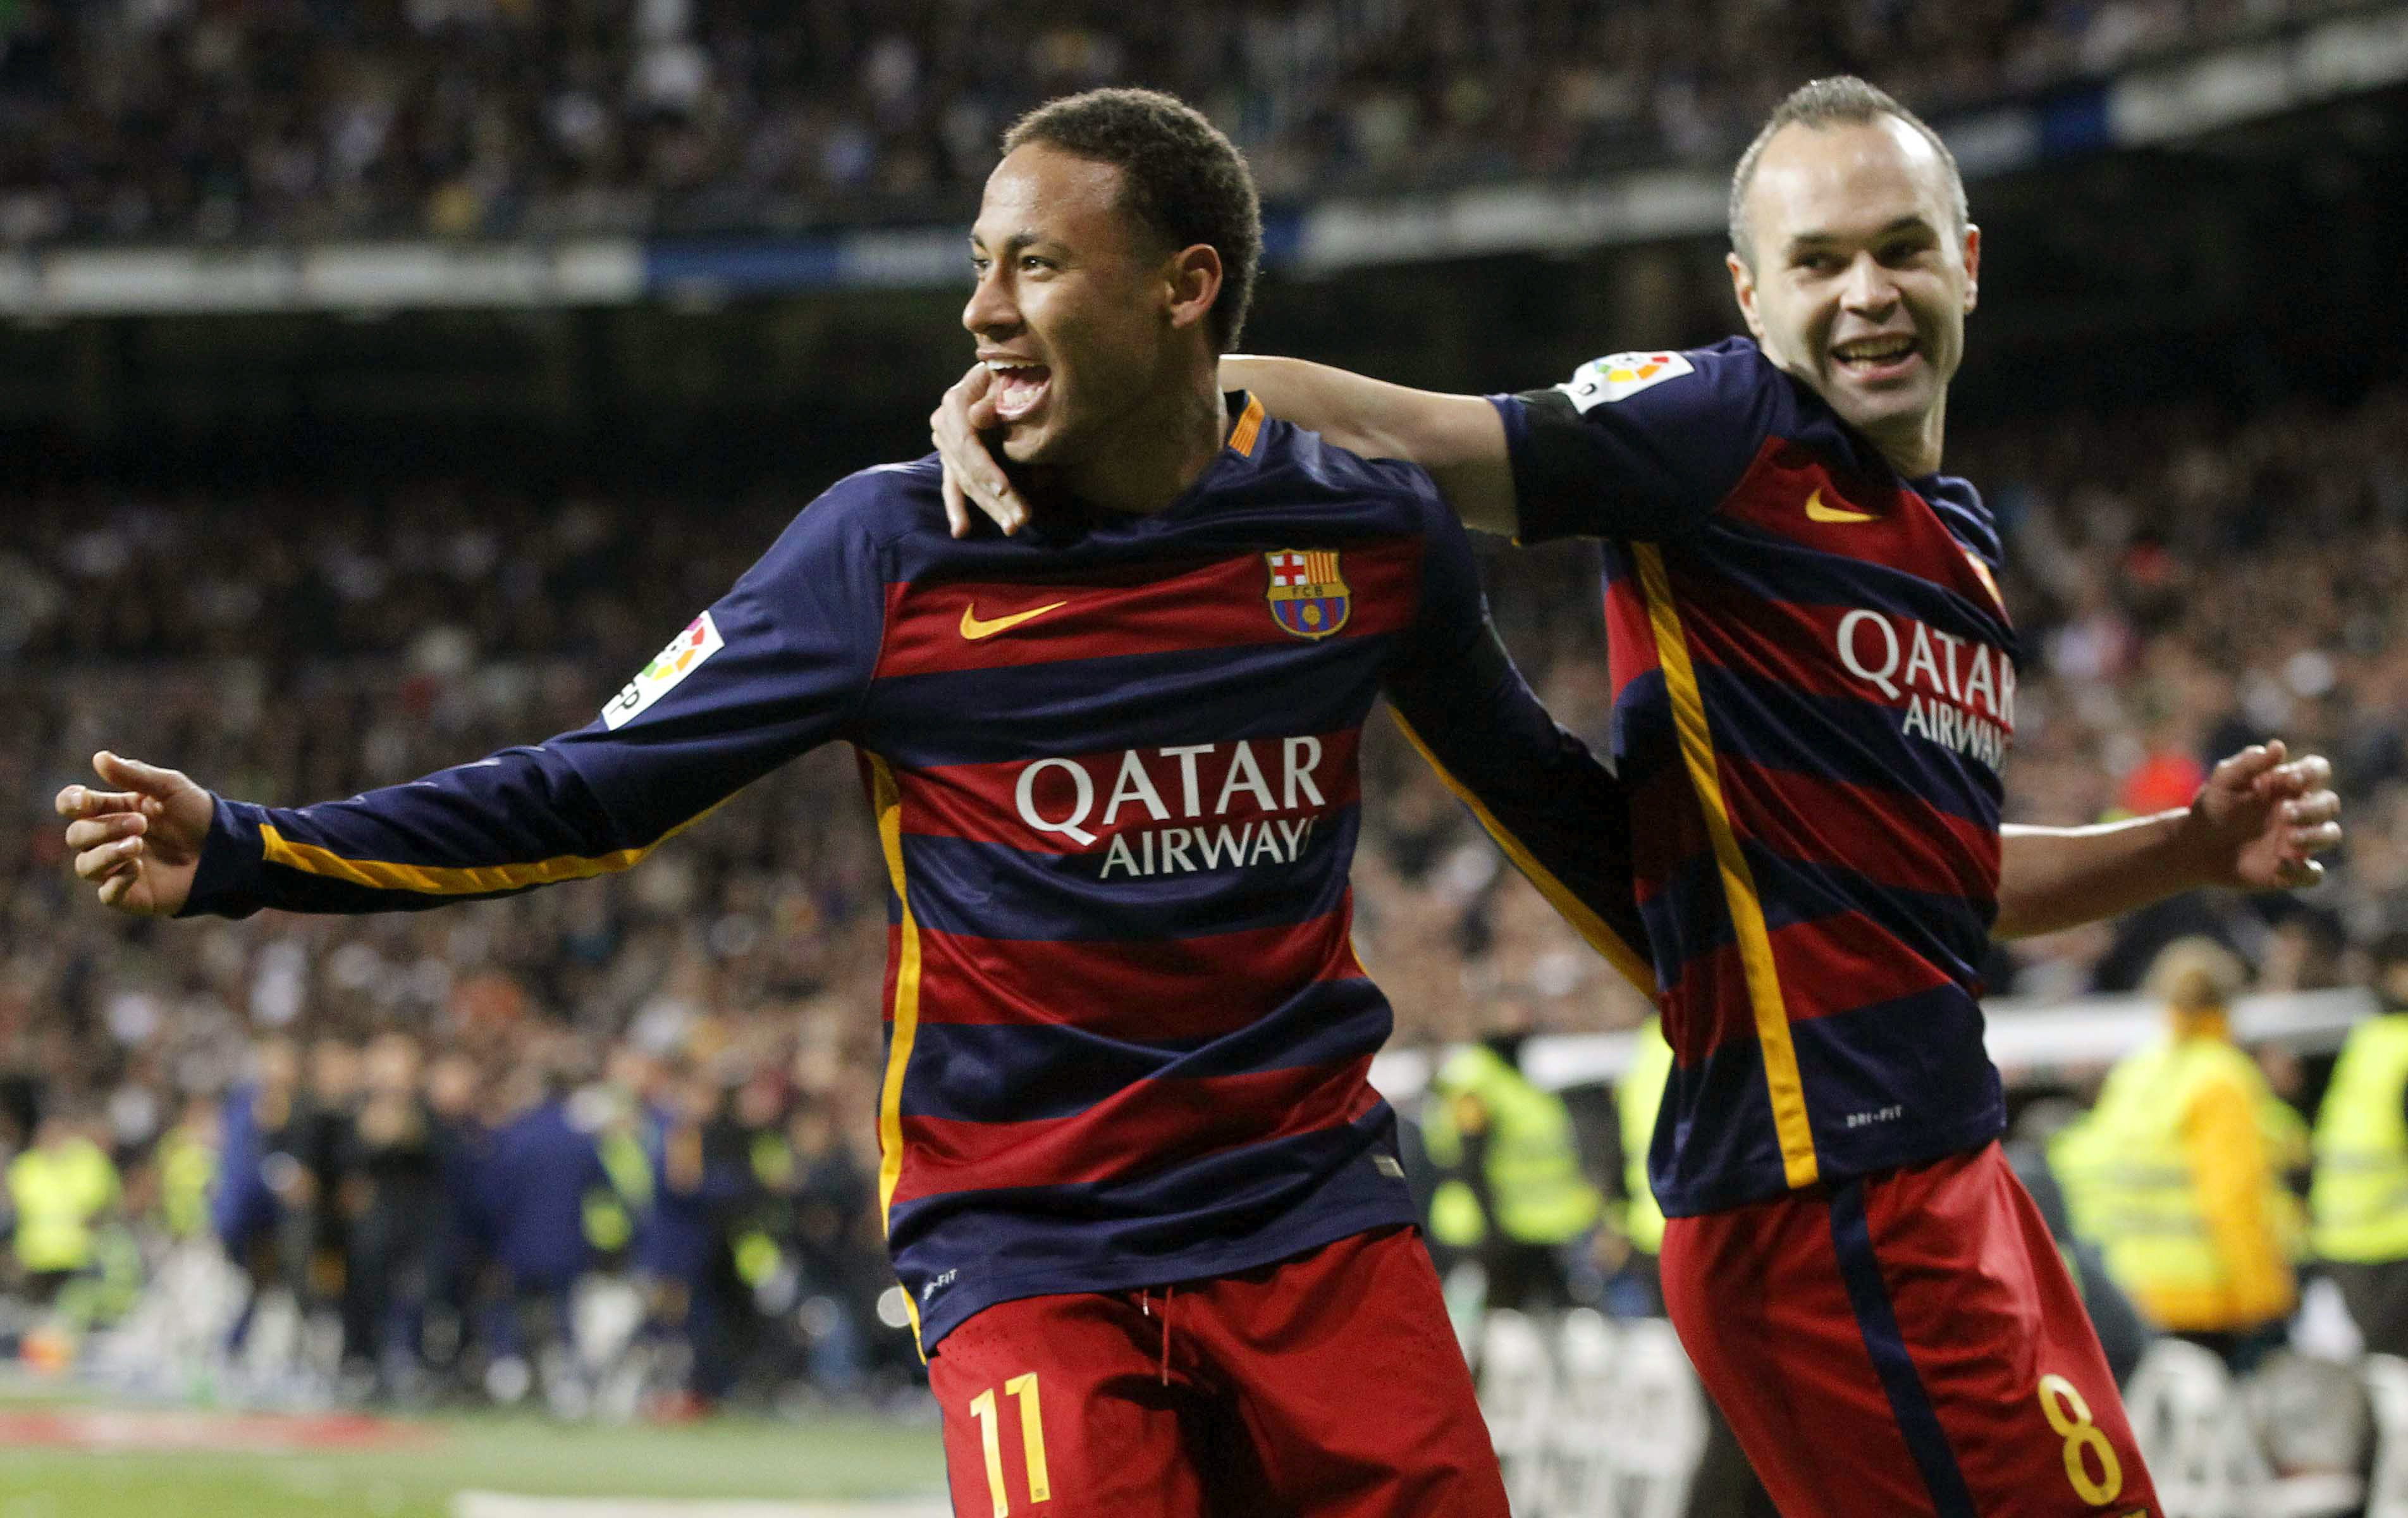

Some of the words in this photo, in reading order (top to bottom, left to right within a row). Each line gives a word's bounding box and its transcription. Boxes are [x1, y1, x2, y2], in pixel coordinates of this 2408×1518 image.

[1015, 736, 1325, 846] QATAR
[1099, 816, 1318, 879] AIRWAY
[1847, 1104, 1902, 1128] DRI-FIT
[969, 1371, 1051, 1518] 11
[2038, 1374, 2122, 1506] 8
